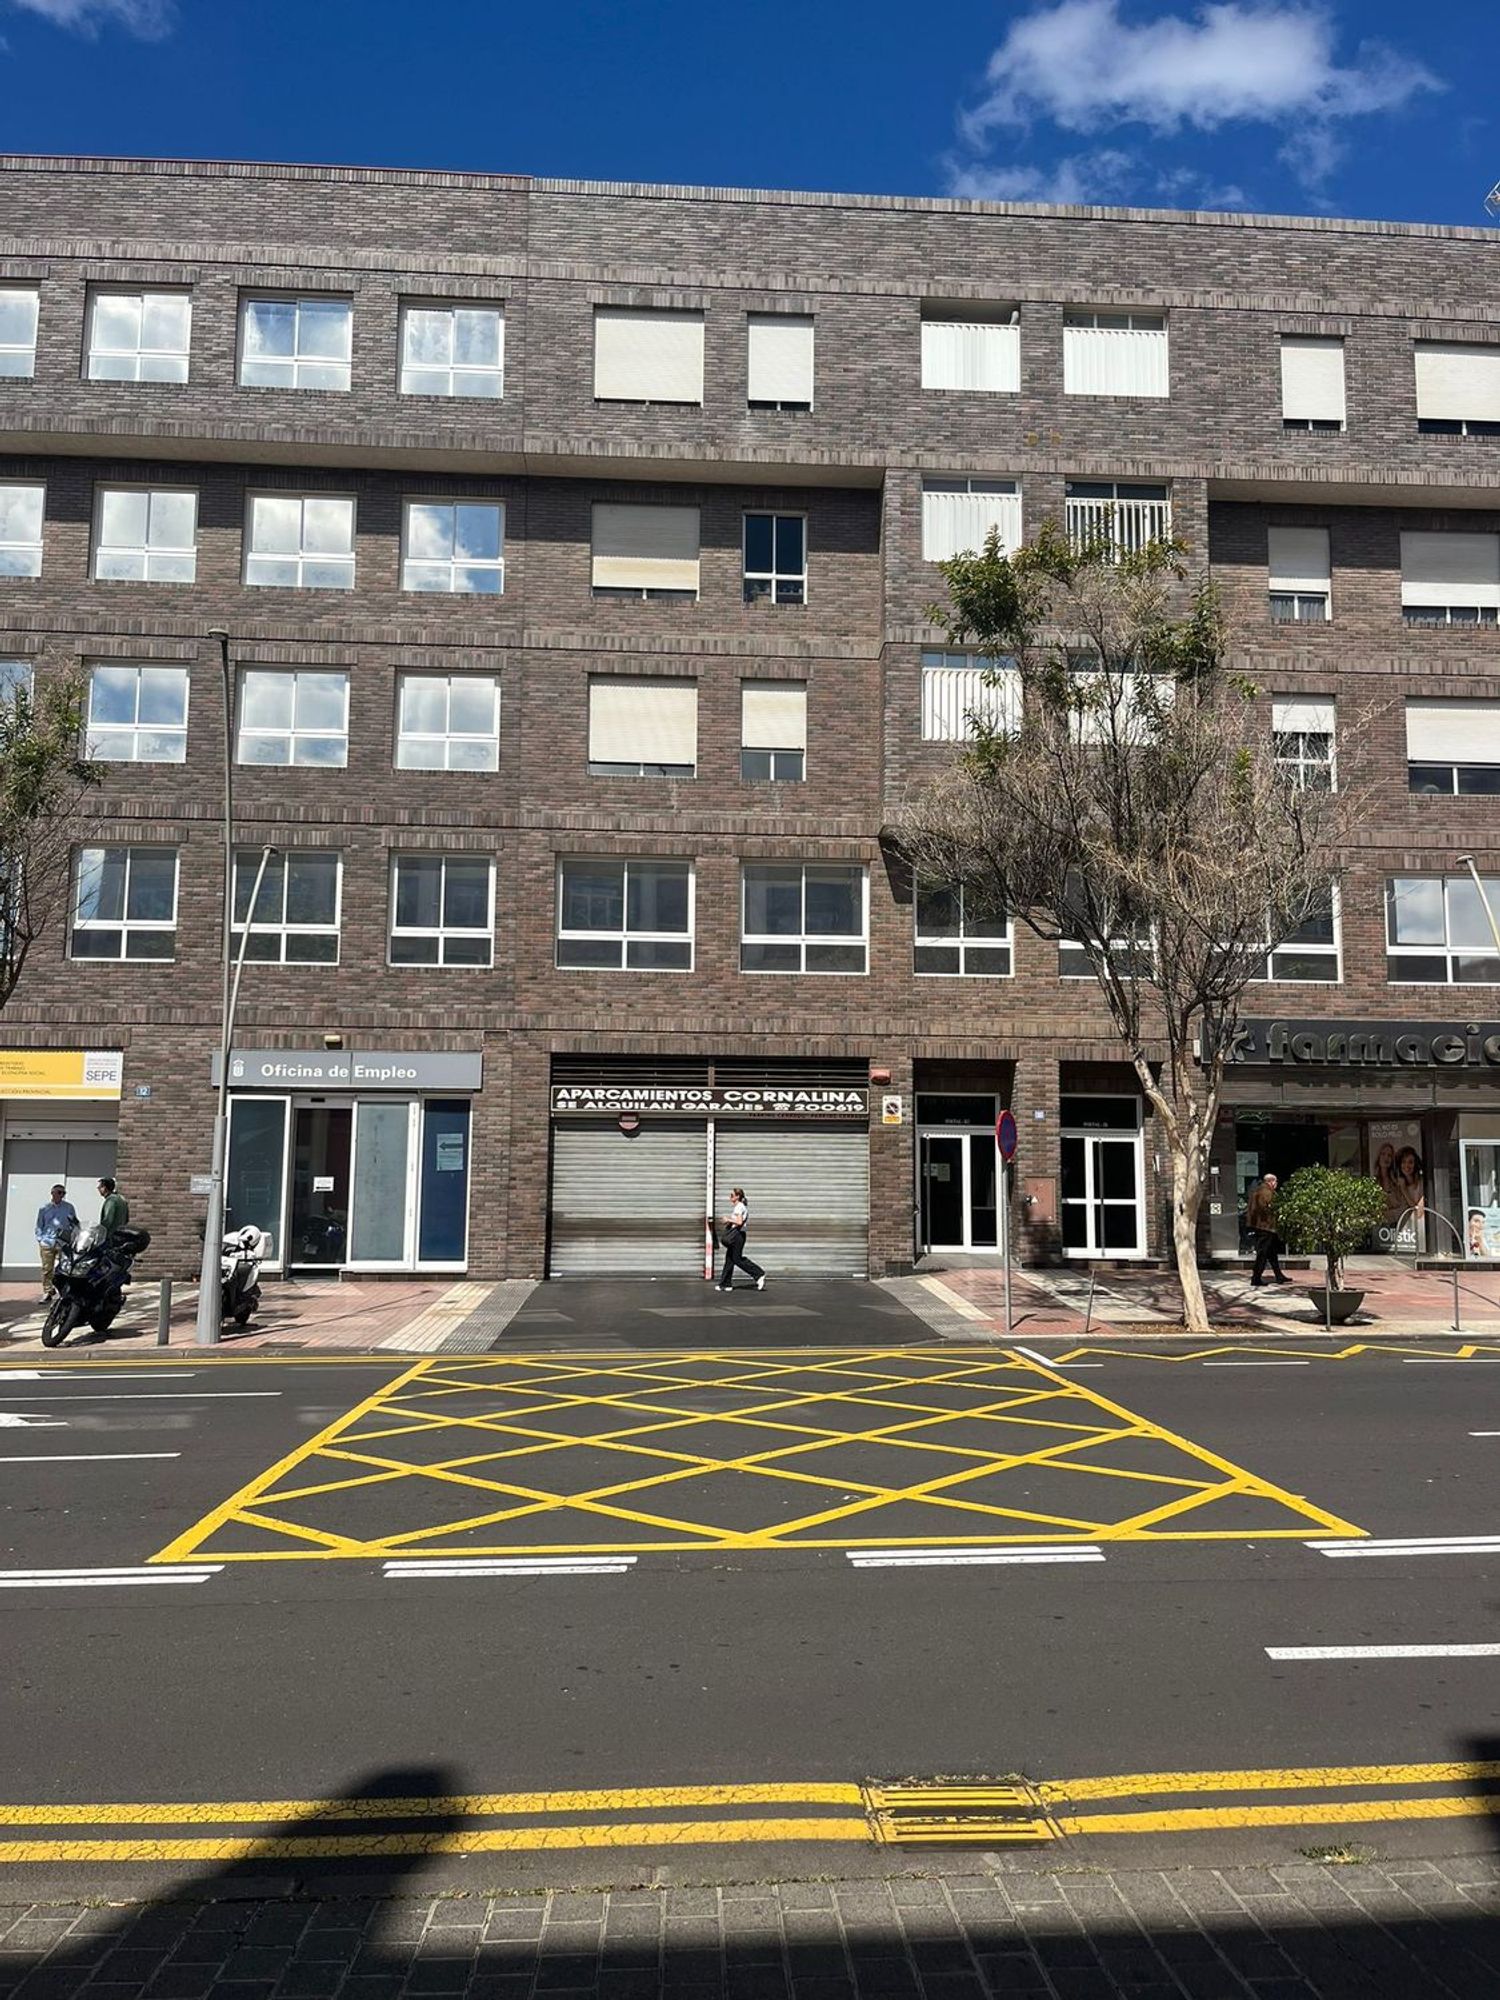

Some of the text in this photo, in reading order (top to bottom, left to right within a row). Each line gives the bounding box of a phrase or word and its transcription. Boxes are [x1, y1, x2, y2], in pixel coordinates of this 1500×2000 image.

[86, 1070, 118, 1081] SEPE
[261, 1063, 417, 1080] Oficina de Empleo
[556, 1088, 863, 1102] APARCAMIENTOS CORNALINA
[556, 1101, 865, 1111] SE ALQUILAN GARAJES 200619
[1379, 1227, 1417, 1243] Olistic
